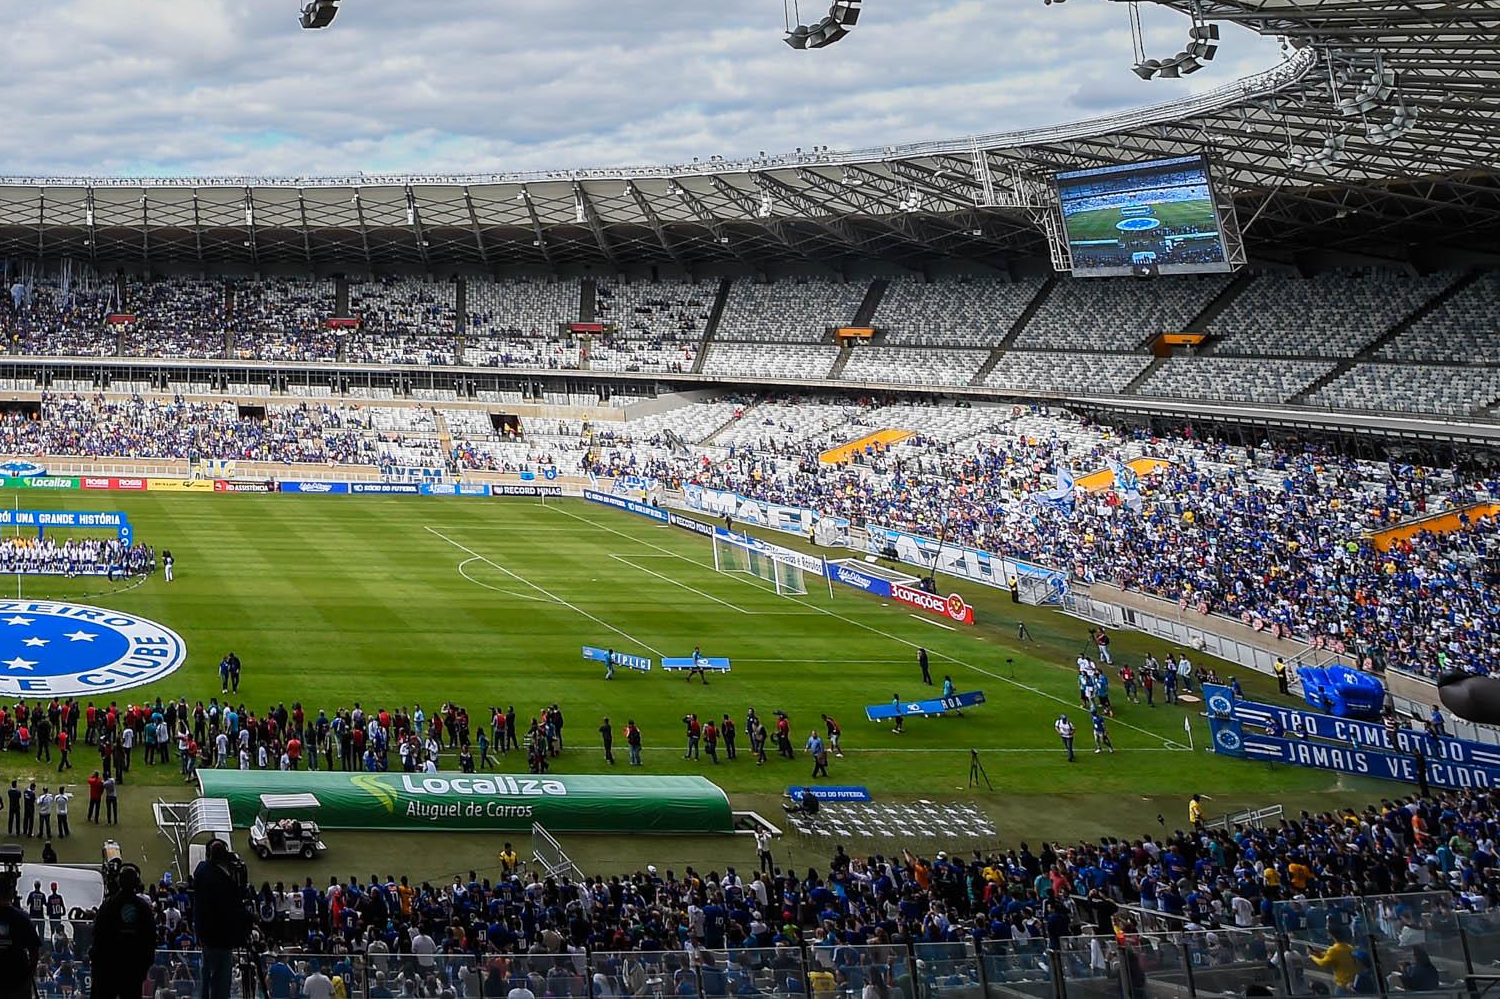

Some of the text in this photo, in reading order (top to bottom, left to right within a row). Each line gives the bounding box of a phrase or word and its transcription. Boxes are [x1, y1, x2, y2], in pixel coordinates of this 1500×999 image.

[32, 477, 71, 488] Localiza
[504, 486, 562, 496] RECORD MINAS
[38, 513, 75, 525] GRANDE
[79, 512, 121, 525] HISTÓRIA
[77, 636, 169, 687] CLUBE
[1278, 709, 1318, 737] TÃO
[1288, 742, 1369, 773] JAMAIS
[402, 774, 567, 795] Localiza
[405, 800, 533, 820] Aluguel de Carros
[51, 903, 61, 914] 10
[714, 916, 724, 925] 10
[84, 976, 92, 988] 9
